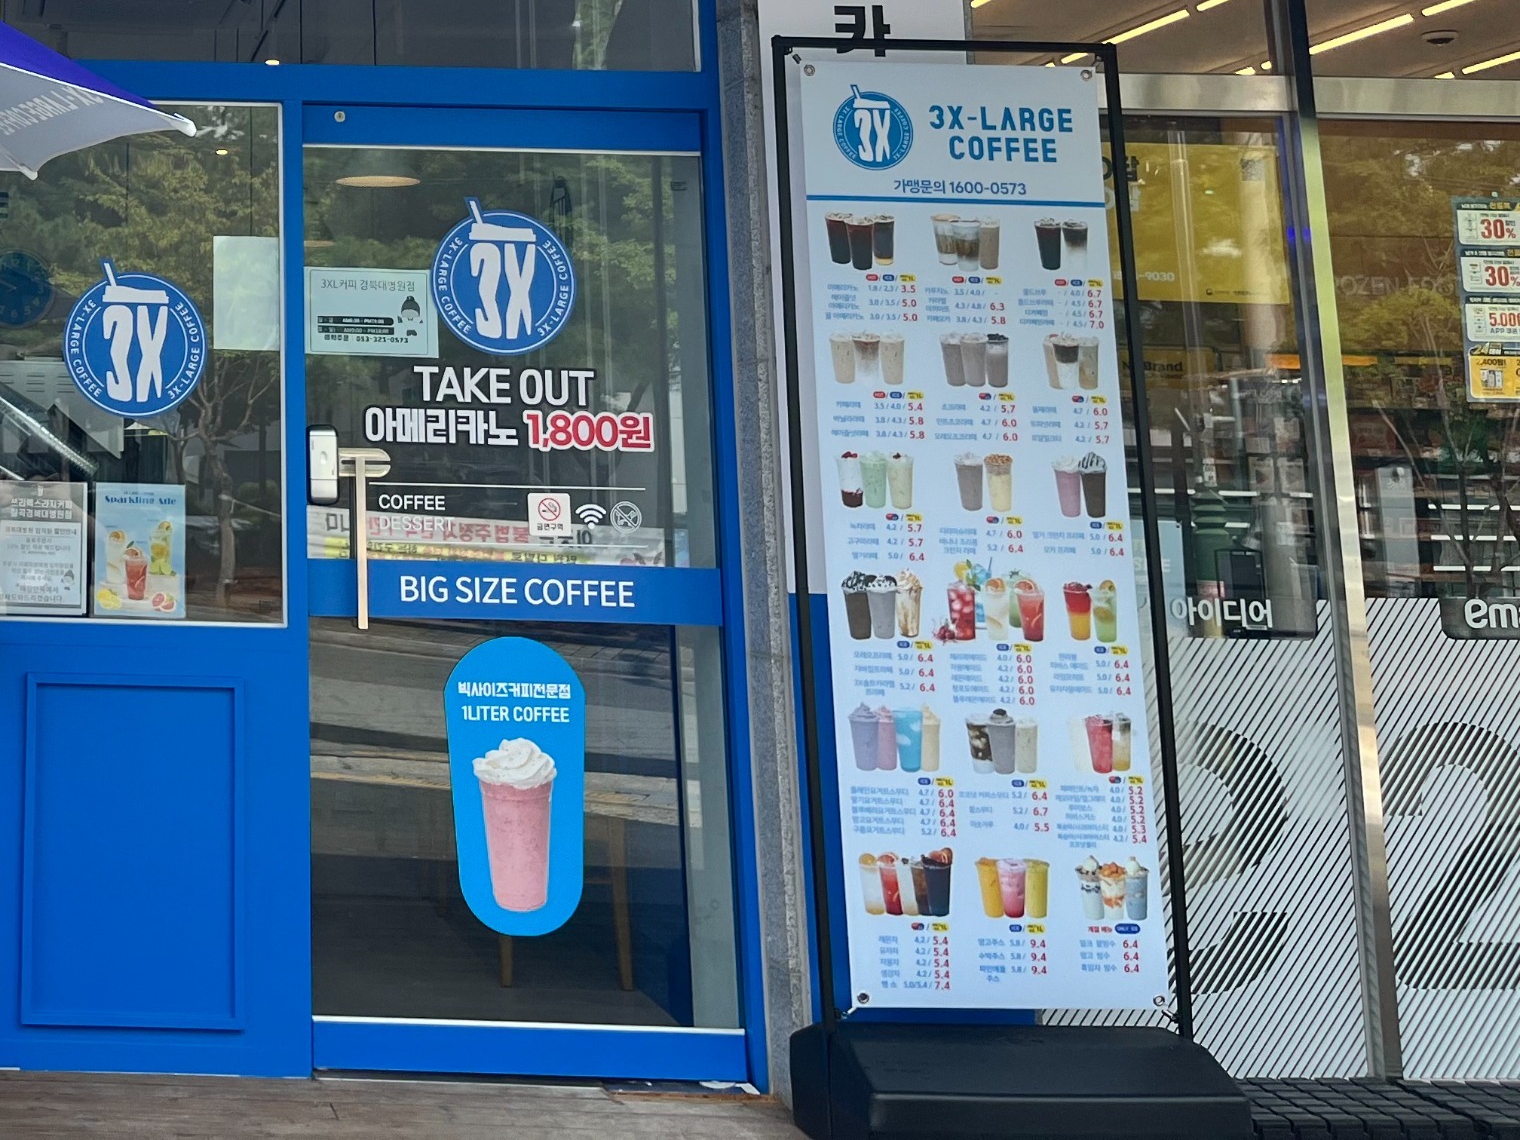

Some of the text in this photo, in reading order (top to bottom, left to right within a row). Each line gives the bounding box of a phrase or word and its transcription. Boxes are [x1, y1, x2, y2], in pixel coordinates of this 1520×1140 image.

[929, 104, 1073, 133] 3X-LARGE
[854, 109, 891, 162] 3X
[949, 135, 1057, 163] COFFEE
[893, 179, 1027, 196] 가맹문의 1600-0573
[1480, 219, 1516, 239] 30%
[320, 278, 357, 291] 3XL커피
[437, 236, 472, 335] 3X-LARGE COFFEE
[470, 243, 537, 340] 3X
[538, 240, 570, 338] 3X-LARGE COFFEE
[69, 299, 102, 398] 3X-LARGE COFFEE
[102, 304, 169, 403] 3X
[168, 302, 200, 400] 3X-LARGE COFFEE
[414, 366, 595, 407] TAKE OUT
[365, 407, 653, 451] 아메리카노 1,800원
[104, 495, 177, 505] Sparkling Ade
[378, 495, 446, 511] COFFEE
[378, 516, 454, 532] DESSERT
[536, 522, 564, 532] 금연구역
[399, 575, 635, 608] BIG SIZE COFFEE
[1171, 597, 1273, 629] 아이디어
[1464, 598, 1520, 629] em
[458, 681, 571, 700] 빅사이즈커피전문점
[461, 705, 570, 723] 1LITER COFFEE
